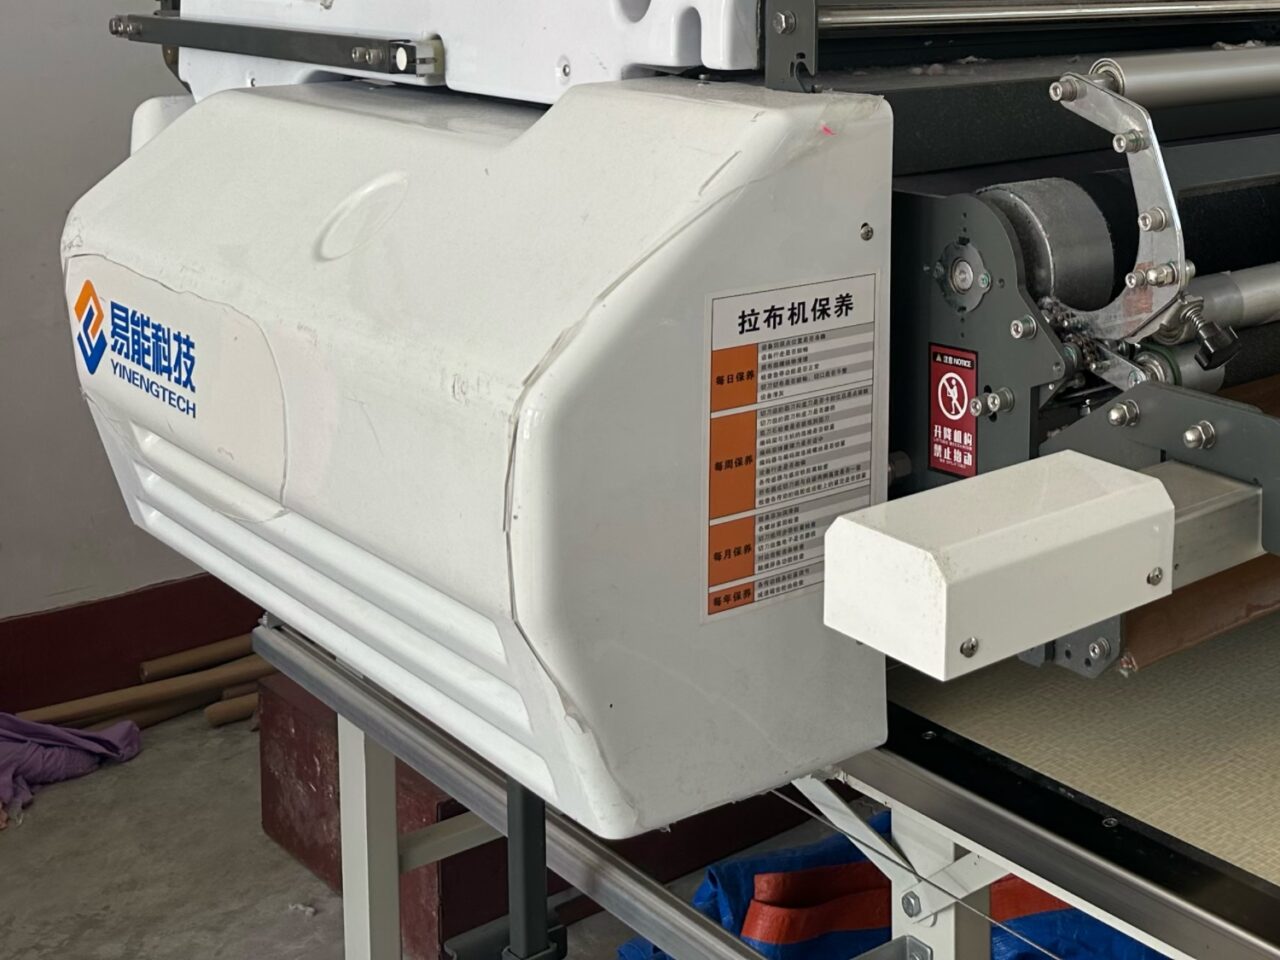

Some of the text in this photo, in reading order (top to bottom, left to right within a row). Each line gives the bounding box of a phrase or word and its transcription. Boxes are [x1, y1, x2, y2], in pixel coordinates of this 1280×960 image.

[737, 293, 855, 335] 拉布机保养
[953, 357, 972, 368] NOTICE
[715, 369, 755, 386] 每日保养
[110, 358, 197, 419] YINENGTECH
[933, 425, 973, 446] 升降机构
[714, 455, 754, 473] 每周保养
[713, 543, 753, 563] 每月保养
[712, 589, 752, 608] 每年保养
